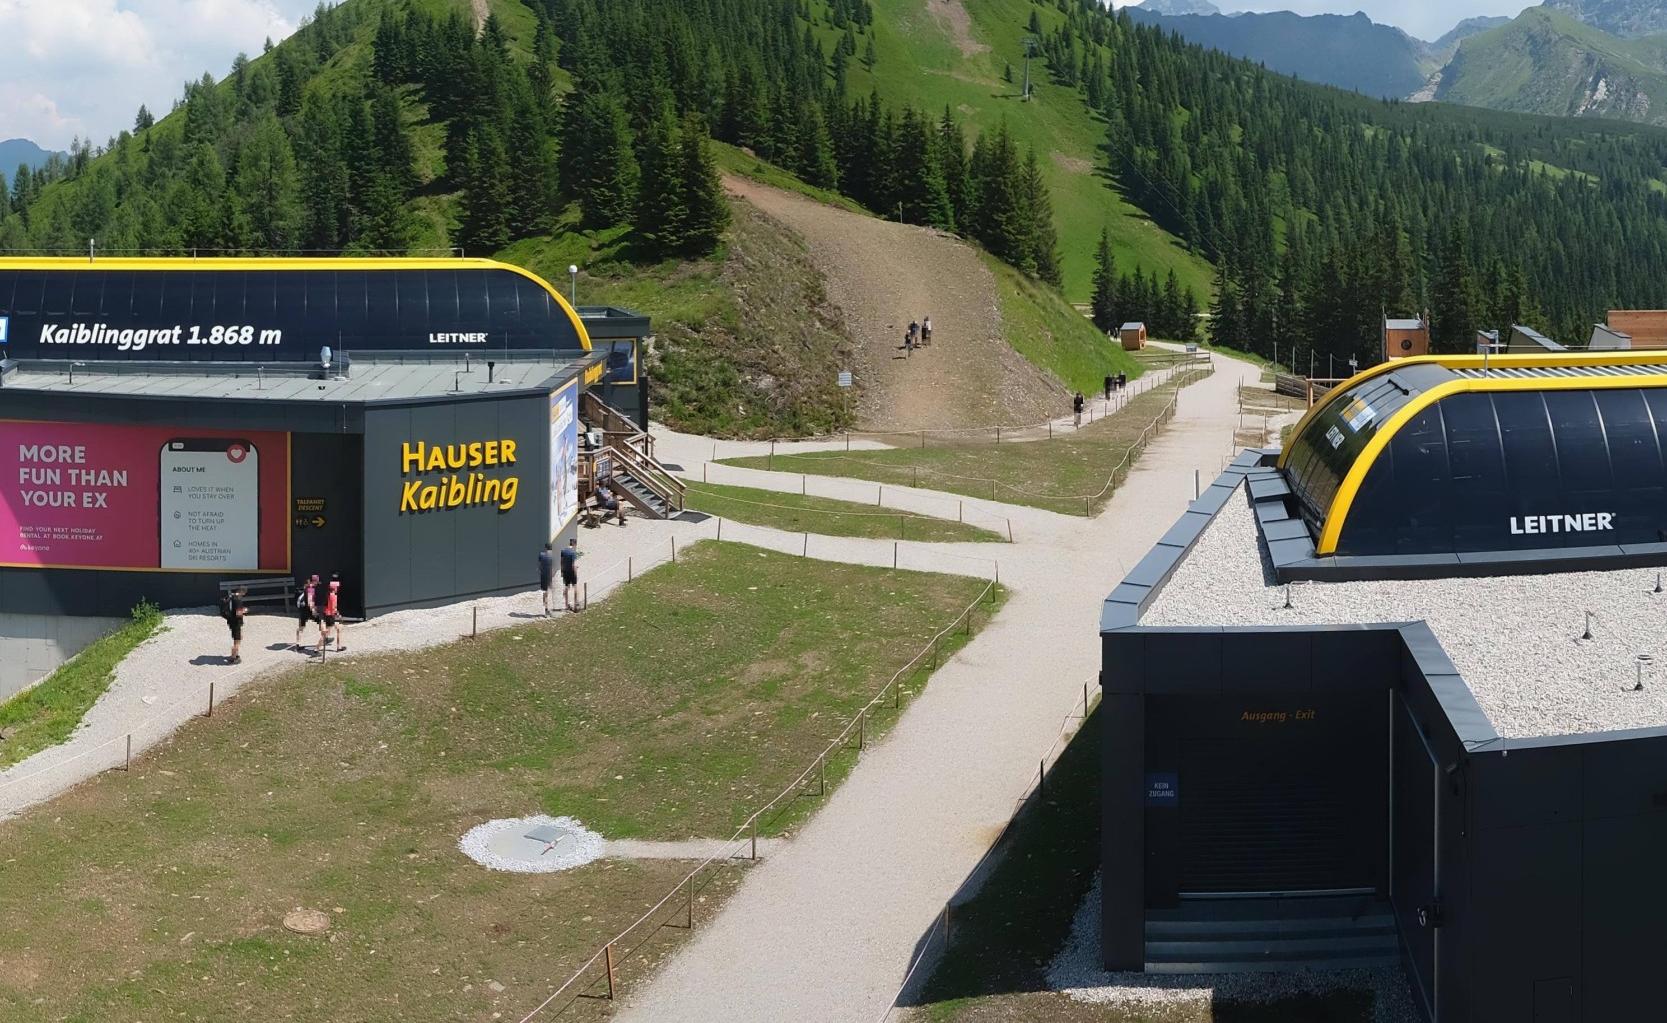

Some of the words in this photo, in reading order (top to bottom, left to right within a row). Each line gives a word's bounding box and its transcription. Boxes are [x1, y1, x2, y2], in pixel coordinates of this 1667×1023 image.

[40, 323, 182, 351] Kaiblinggrat
[187, 325, 255, 345] 1.868
[259, 328, 283, 345] m
[430, 333, 488, 343] LEITNER
[19, 444, 86, 464] MORE
[402, 439, 517, 473] HAUSER
[19, 467, 61, 485] FUN
[67, 469, 128, 487] THAN
[20, 490, 76, 508] YOUR
[82, 492, 108, 509] EX
[400, 473, 519, 512] Kaibling
[1510, 512, 1615, 535] LEITNER
[27, 544, 50, 552] keyone
[1241, 710, 1287, 723] Ausgang
[1295, 709, 1316, 720] Exit
[1148, 790, 1175, 798] ZUGANG
